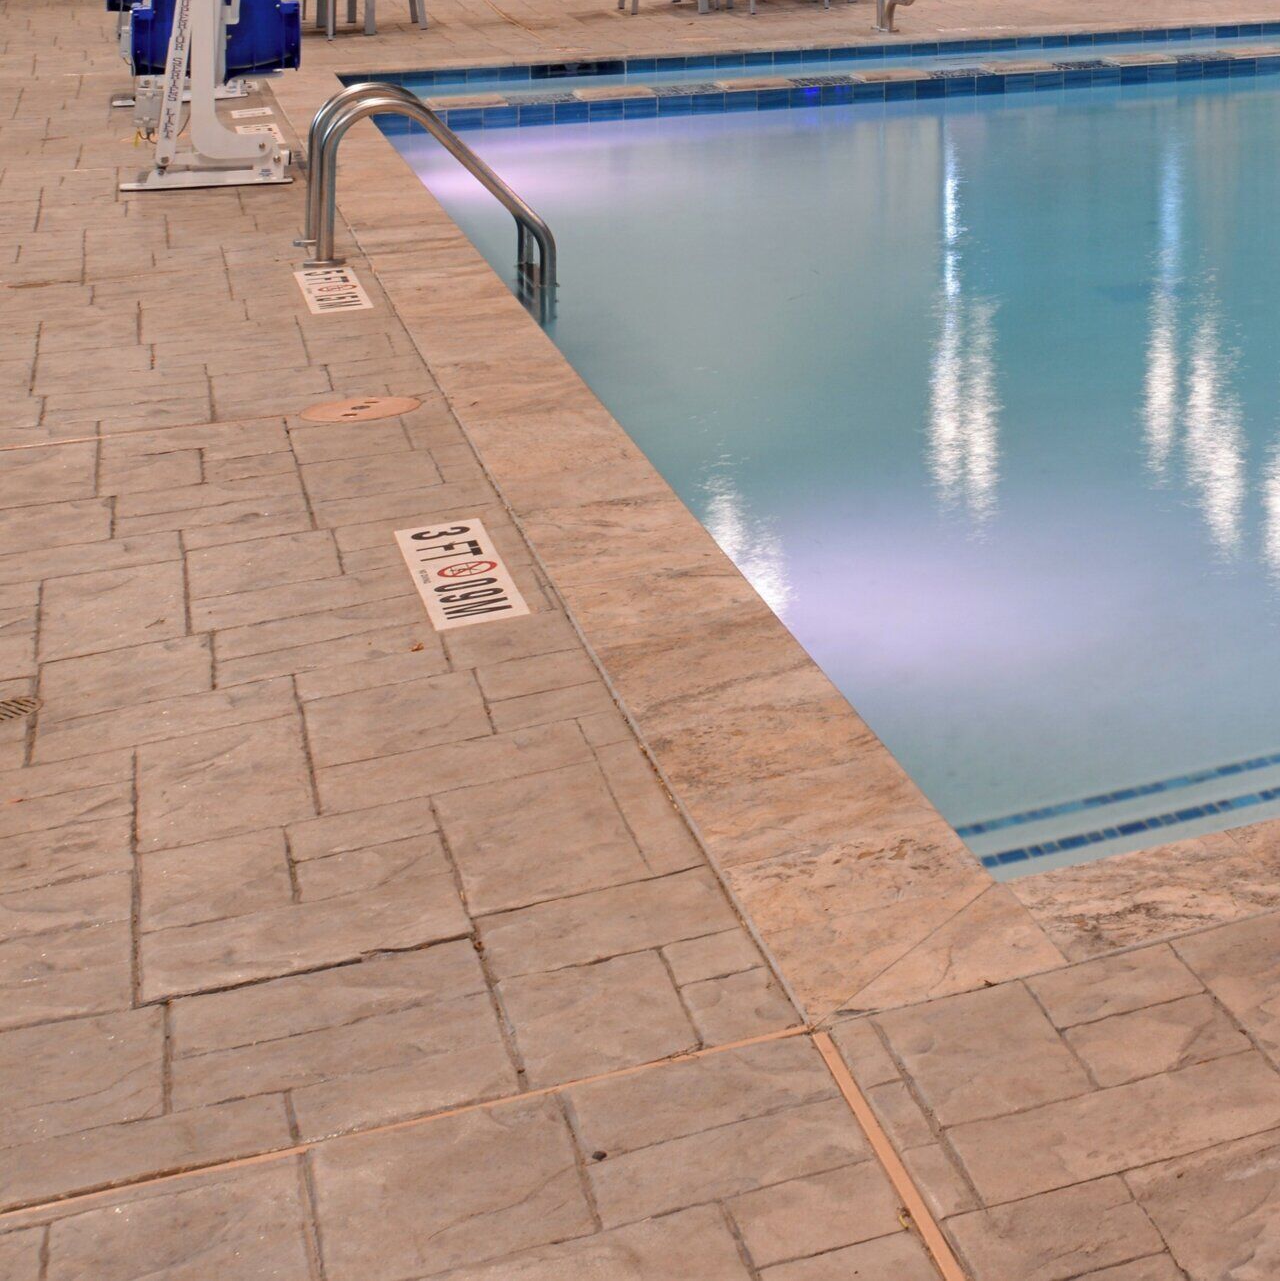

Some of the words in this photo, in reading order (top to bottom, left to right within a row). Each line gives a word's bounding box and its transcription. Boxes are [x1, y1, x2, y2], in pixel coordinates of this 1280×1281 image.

[167, 57, 182, 102] SERIES
[410, 526, 470, 540] 3
[416, 540, 483, 562] FT
